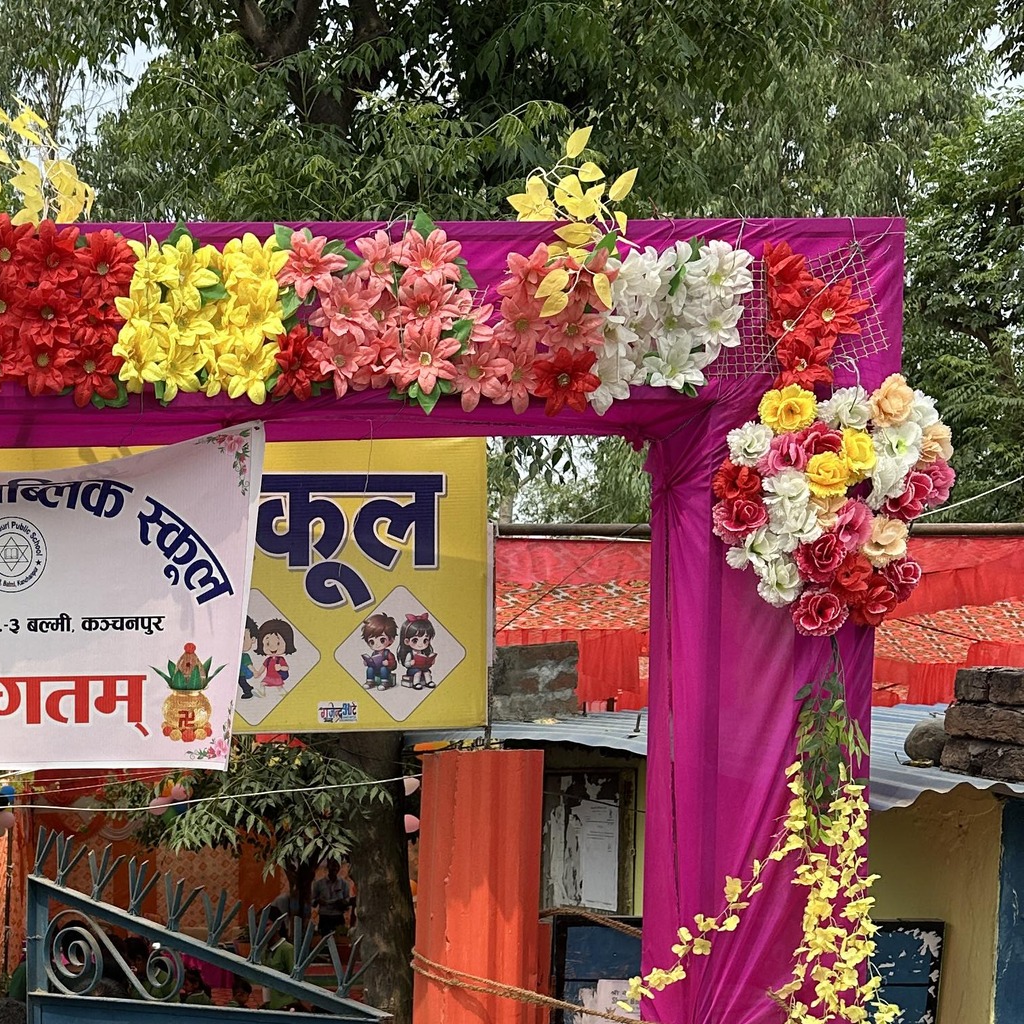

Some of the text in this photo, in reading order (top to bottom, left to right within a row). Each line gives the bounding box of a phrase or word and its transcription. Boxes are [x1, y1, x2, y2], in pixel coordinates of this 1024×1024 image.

[11, 521, 31, 535] Public
[30, 532, 43, 557] School
[137, 495, 234, 605] स्कूल
[81, 616, 165, 635] कञ्चनपुर
